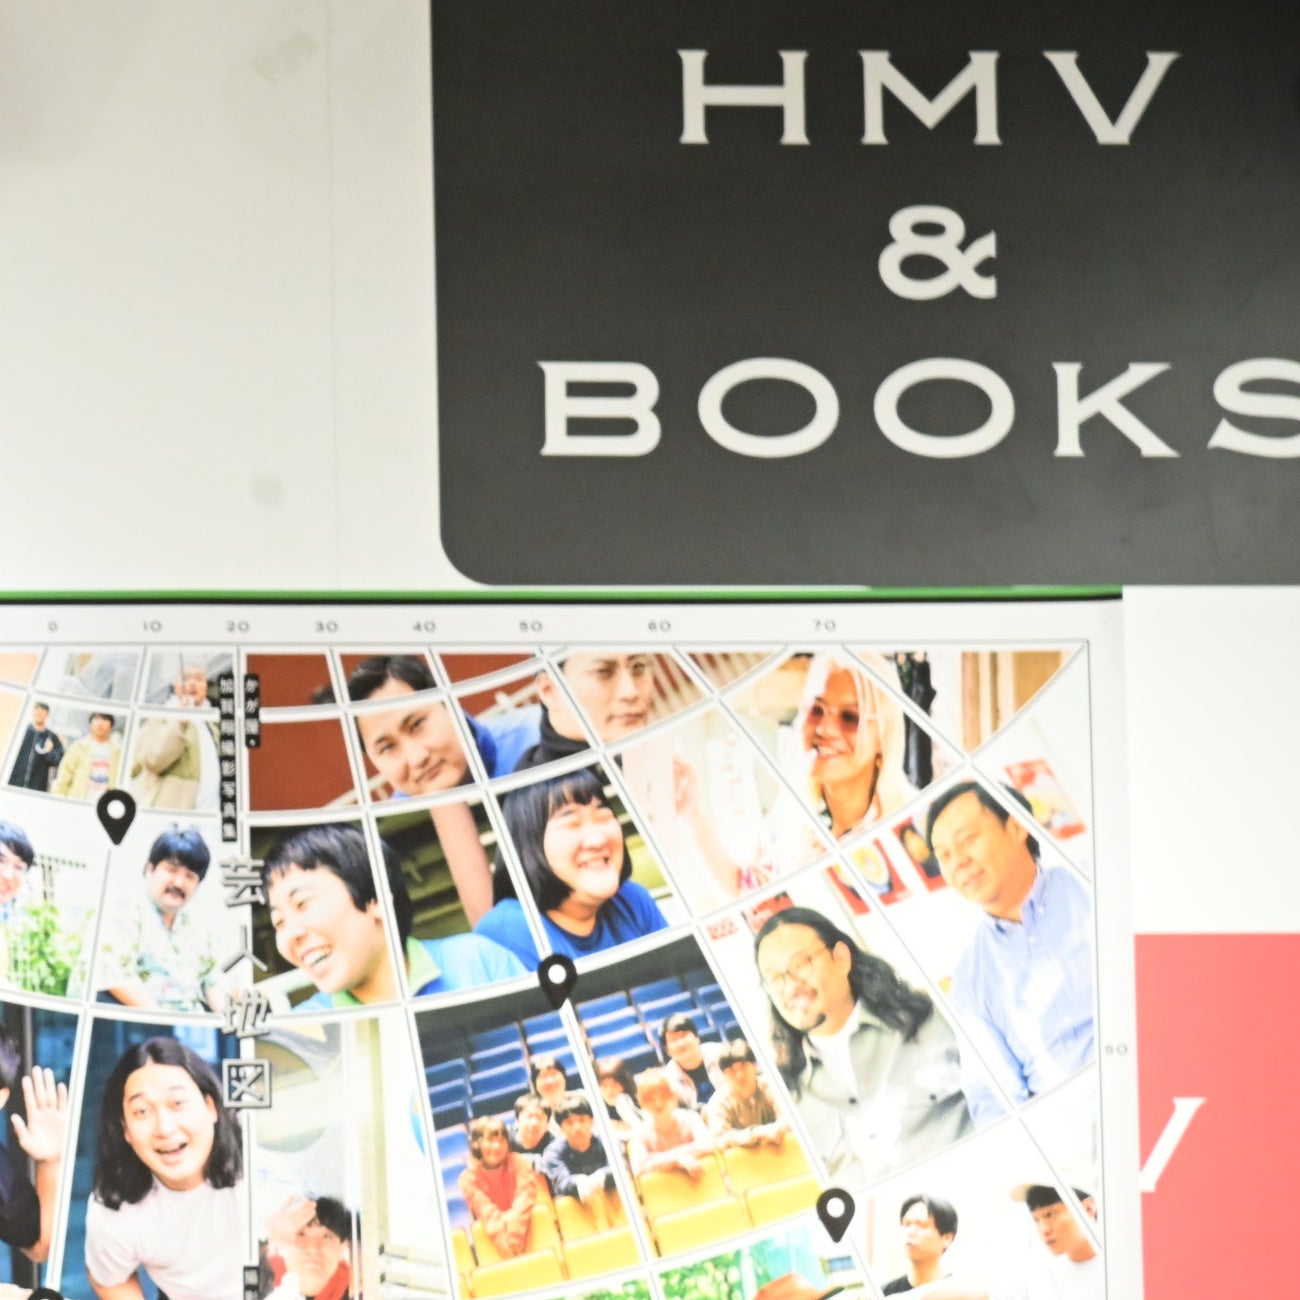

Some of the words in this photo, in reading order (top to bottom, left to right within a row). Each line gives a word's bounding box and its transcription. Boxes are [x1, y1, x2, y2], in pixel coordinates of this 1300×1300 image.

[678, 50, 1182, 145] HMV
[877, 205, 998, 300] &
[537, 357, 1300, 458] BOOKS
[141, 620, 163, 633] 10
[226, 620, 250, 633] 20
